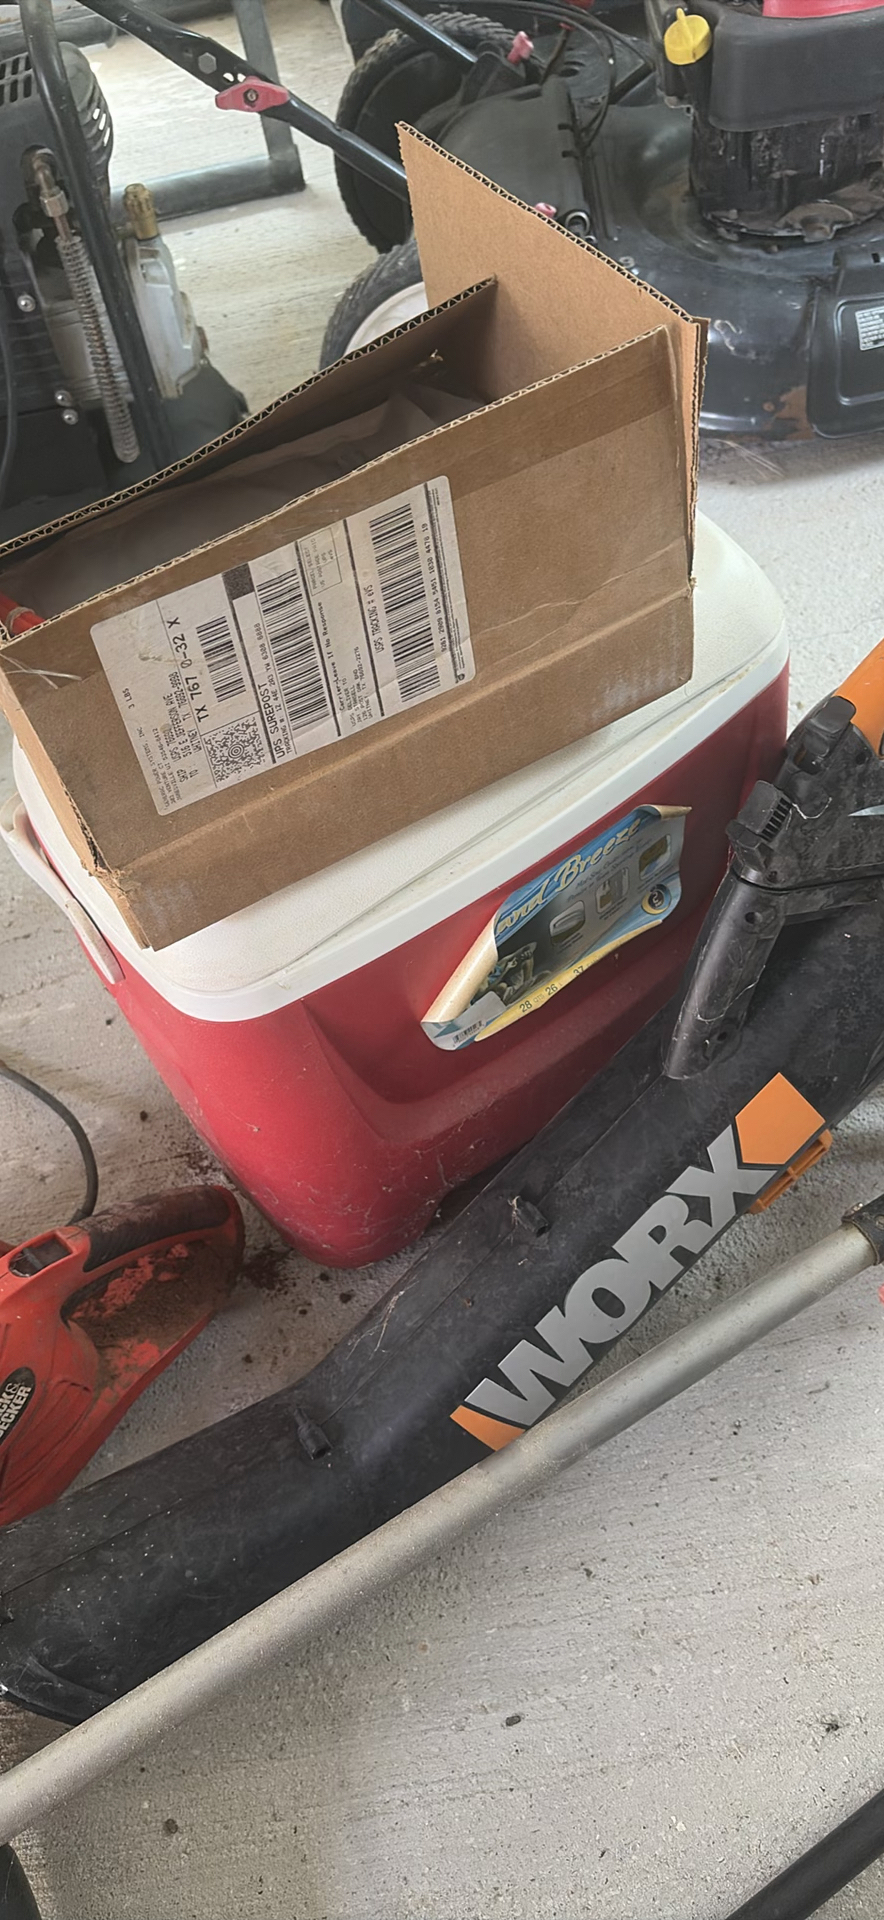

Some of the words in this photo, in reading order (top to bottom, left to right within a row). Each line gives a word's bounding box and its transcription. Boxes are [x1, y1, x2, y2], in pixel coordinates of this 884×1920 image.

[166, 616, 180, 629] X
[315, 600, 329, 636] Response
[367, 604, 381, 636] TRACKING
[171, 632, 193, 670] 0-32
[323, 637, 331, 648] No
[373, 635, 384, 654] USPS
[326, 650, 333, 659] If
[121, 687, 132, 702] LBS
[184, 673, 203, 700] 767
[329, 660, 345, 711] Carrier-Leave
[162, 692, 175, 706] AVE
[256, 680, 279, 735] SUREPOST
[166, 705, 185, 738] JEFFERSON
[181, 711, 192, 721] TX
[194, 703, 210, 722] TX
[186, 727, 202, 753] WHITNEY
[272, 737, 286, 759] UPS
[280, 724, 292, 753] TRACKING
[168, 745, 182, 762] USPS
[180, 744, 192, 758] 516
[175, 766, 188, 783] SHIP
[188, 768, 199, 778] TO
[554, 816, 641, 893] Breeze
[519, 1000, 533, 1013] 28
[545, 983, 559, 997] 26
[464, 1124, 777, 1426] WORX
